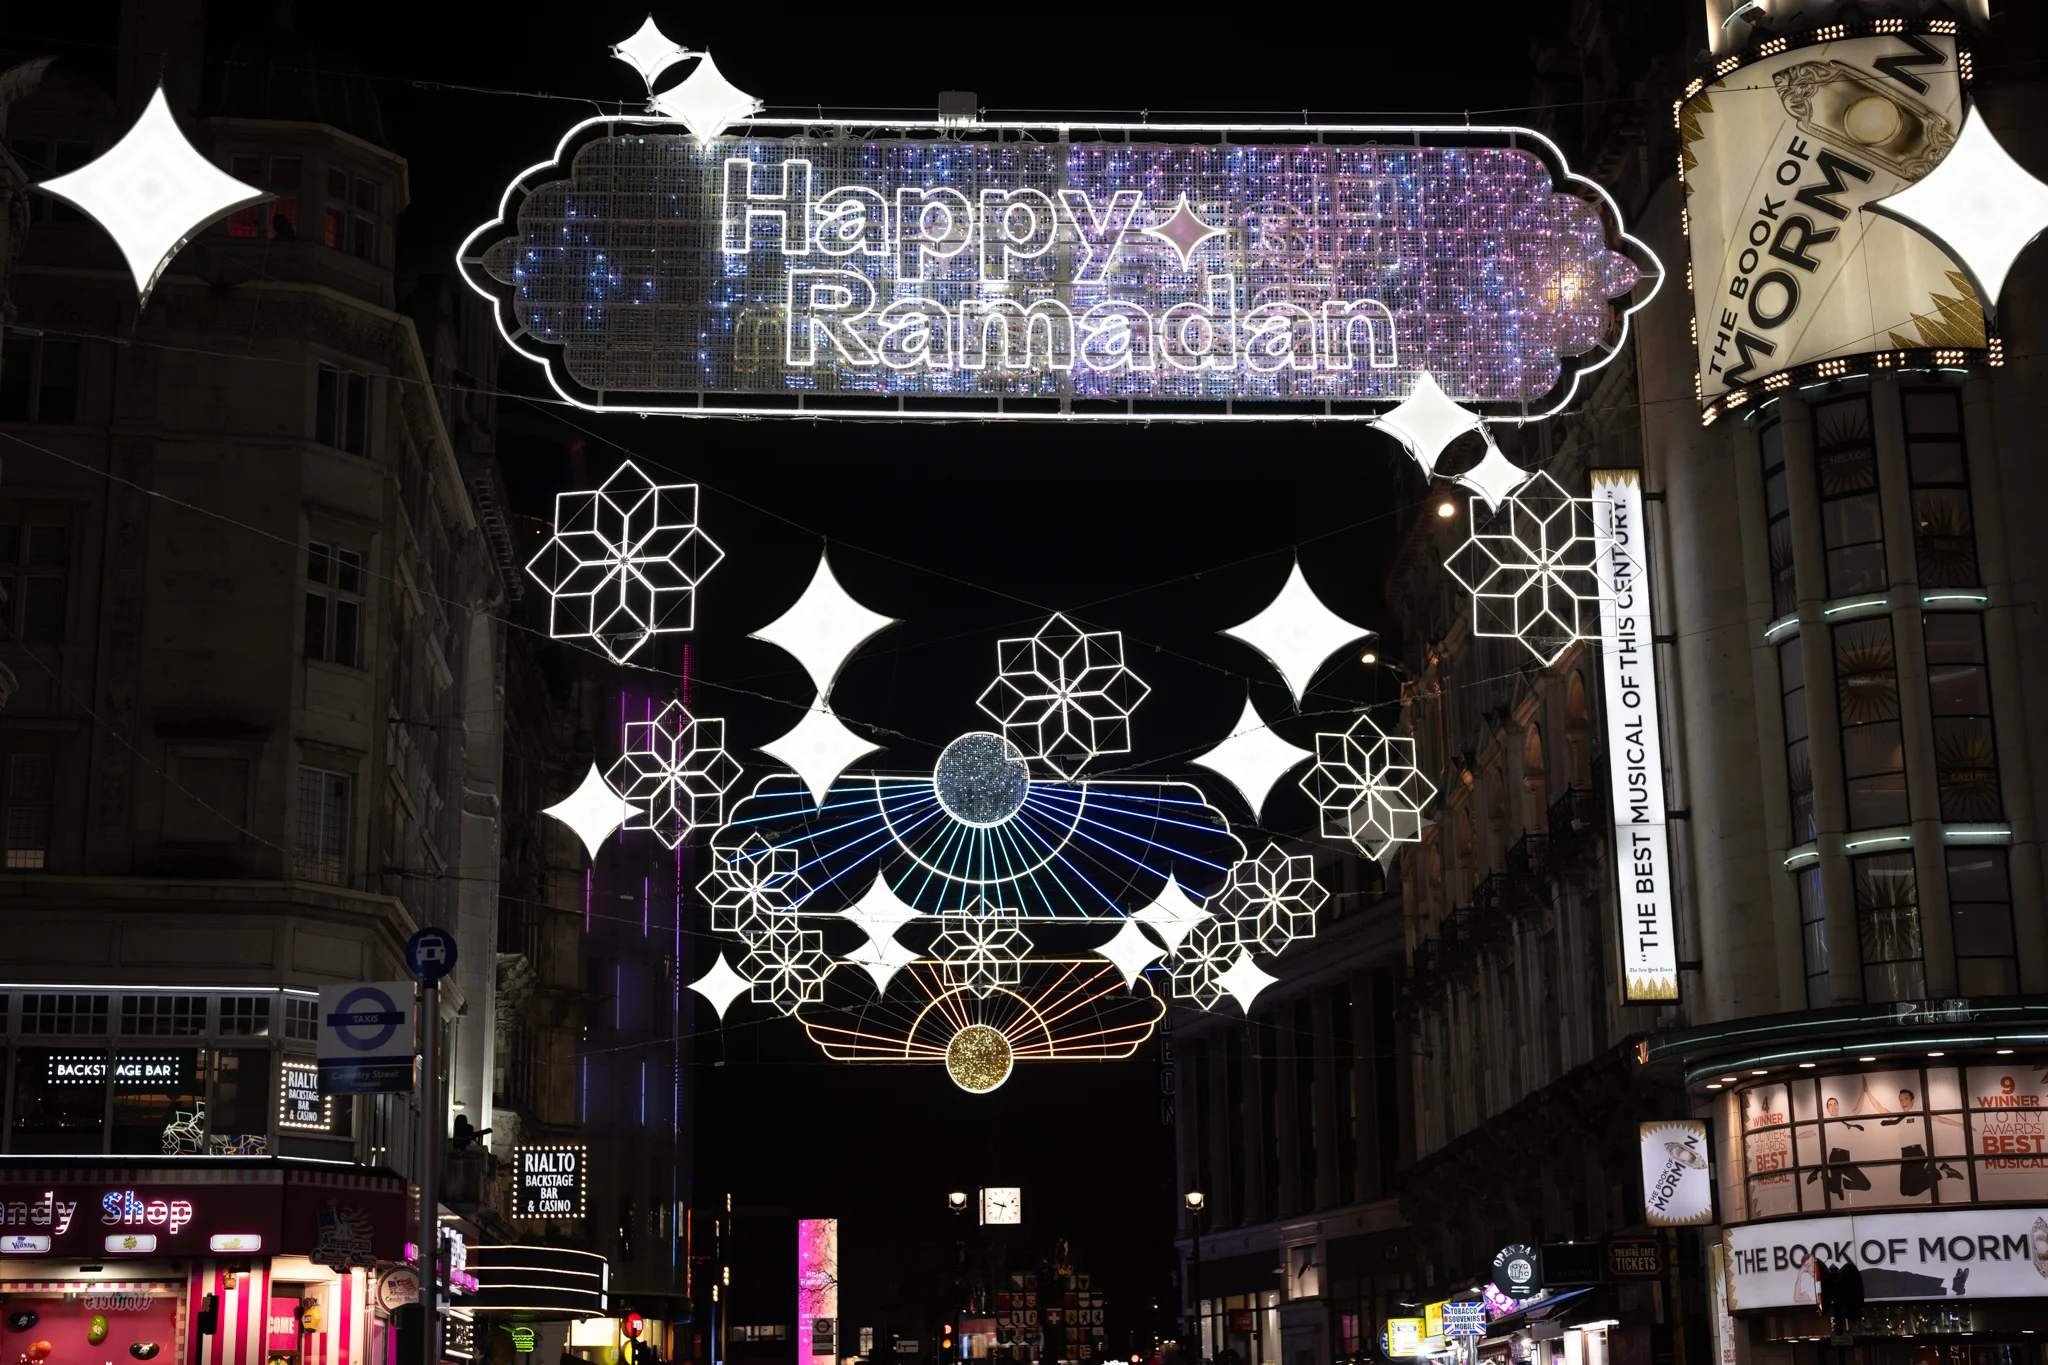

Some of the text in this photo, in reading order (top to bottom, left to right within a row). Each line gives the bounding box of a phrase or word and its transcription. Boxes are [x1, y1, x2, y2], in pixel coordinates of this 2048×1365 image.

[721, 158, 1144, 285] Happy
[1708, 135, 1811, 376] THE BOOK OF
[785, 268, 1399, 371] Ramadan
[1618, 616, 1638, 670] THIS
[1621, 675, 1641, 709] OF
[1624, 714, 1650, 824] MUSICAL
[1632, 832, 1655, 893] BEST
[353, 1014, 379, 1024] TAXIS
[57, 1064, 171, 1076] BACKSTAGE BAR
[331, 1069, 400, 1084] Coventry Street
[2000, 1076, 2015, 1094] 9
[297, 1100, 310, 1111] BAR
[1760, 1096, 1769, 1113] 4
[1977, 1095, 2040, 1108] WINNER
[289, 1110, 318, 1122] & CASINO
[1752, 1112, 1784, 1128] WINNER
[1982, 1134, 2045, 1155] BEST
[525, 1152, 575, 1173] RIALTO
[1756, 1150, 1788, 1172] BEST
[525, 1174, 574, 1187] BACKSTAGE
[1648, 1158, 1674, 1204] THE BOOK OF
[540, 1187, 558, 1199] BAR
[0, 1190, 192, 1235] ndy Shop
[528, 1200, 571, 1212] & CASINO
[1493, 1244, 1531, 1267] OPEN 24
[1614, 1247, 1655, 1257] THEATRE CAFE
[1735, 1247, 1768, 1275] THE
[1773, 1241, 1854, 1271] BOOK
[1860, 1238, 1907, 1266] OF
[1615, 1257, 1656, 1271] TICKETS
[1448, 1315, 1481, 1323] SOUVENIRS
[1450, 1307, 1478, 1315] TOBACCO
[1454, 1322, 1475, 1330] MOBILE
